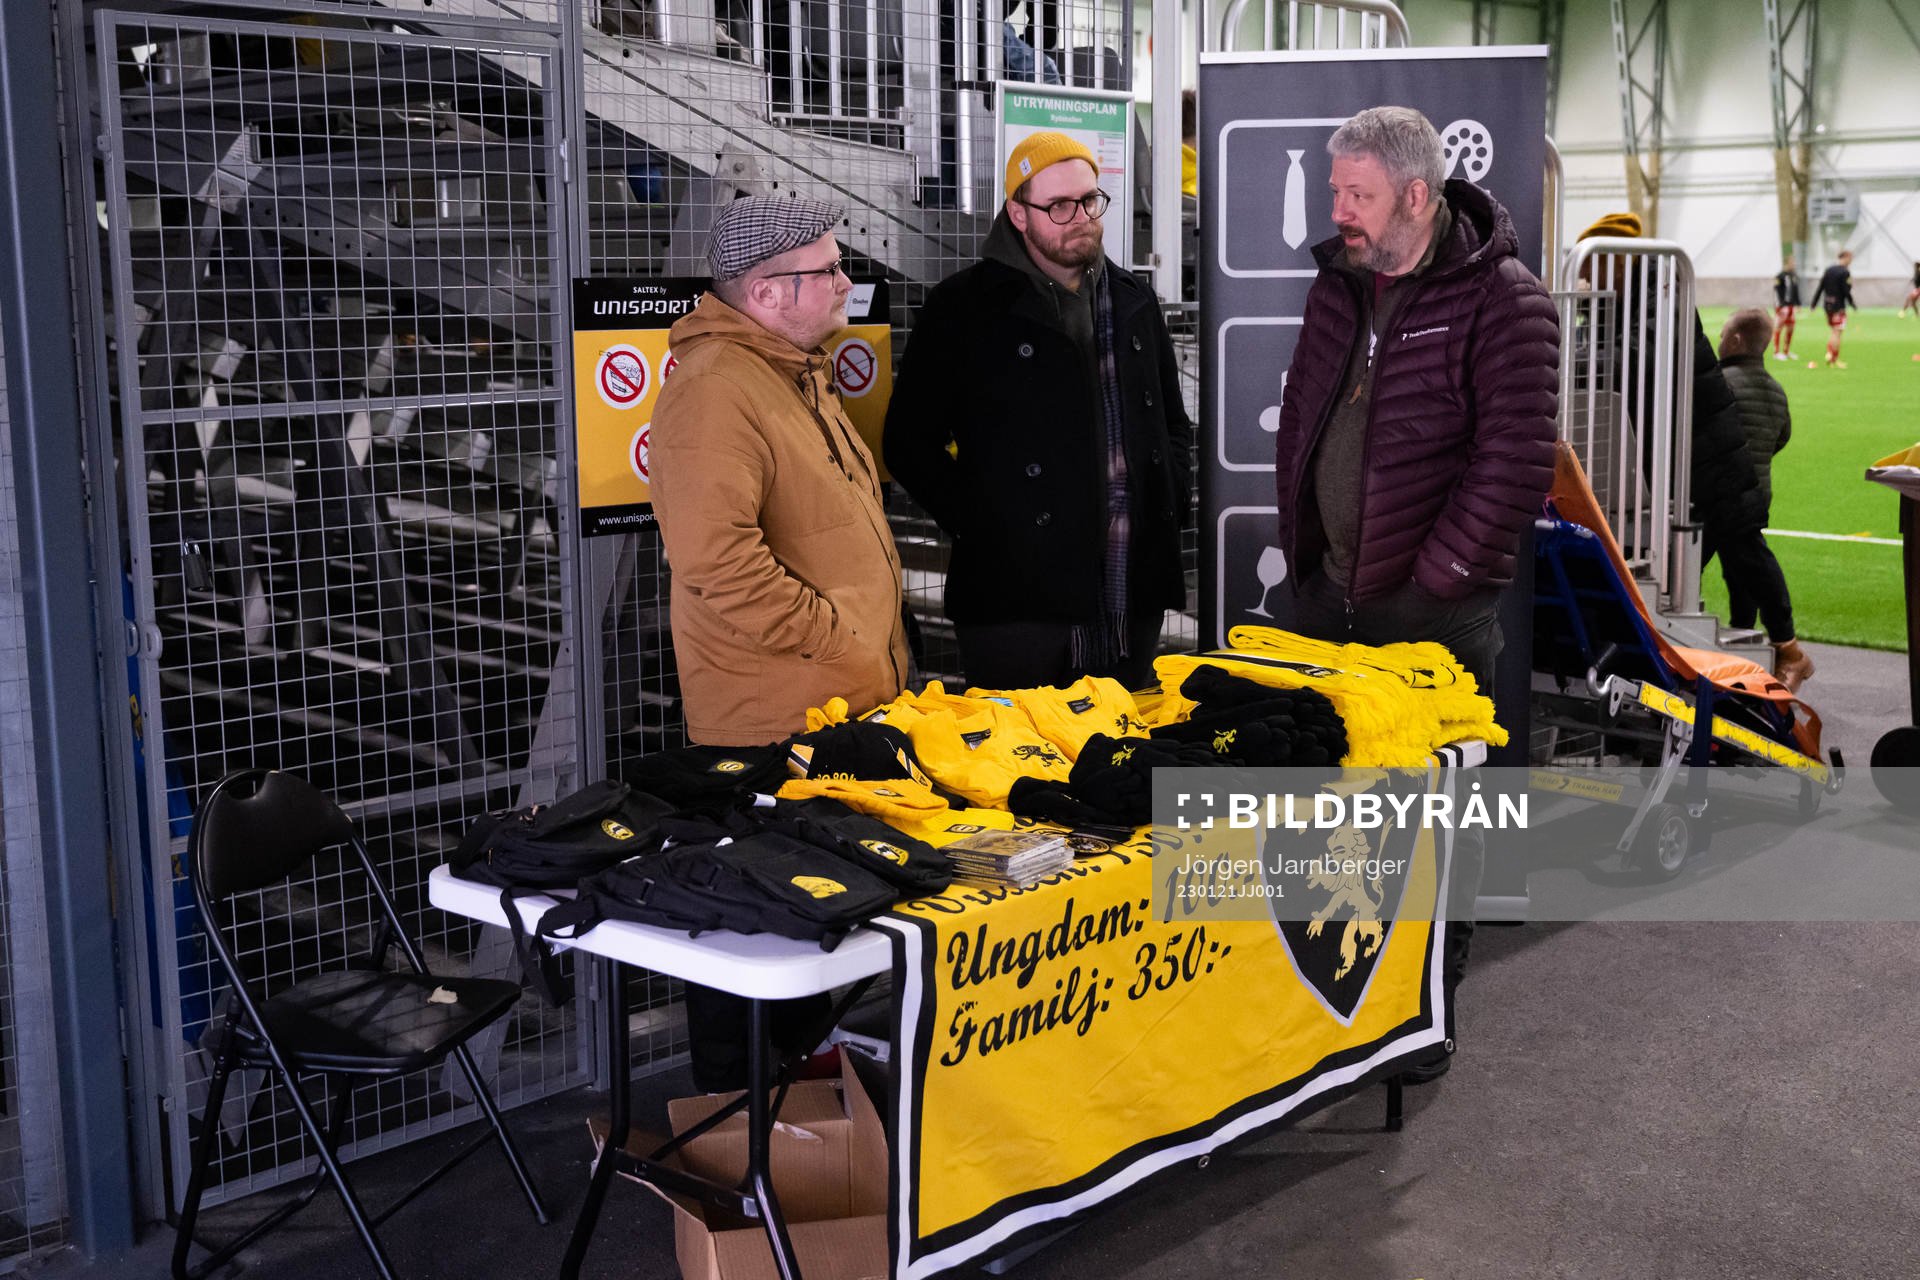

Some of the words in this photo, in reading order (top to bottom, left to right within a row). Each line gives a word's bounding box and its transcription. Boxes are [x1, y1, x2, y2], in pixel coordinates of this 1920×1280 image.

[1013, 95, 1117, 115] UTRYMNINGSPLAN
[633, 286, 659, 294] SALTEX
[659, 286, 667, 295] by
[593, 300, 691, 315] UNISPORT
[947, 897, 1150, 990] Ungdom:
[940, 966, 1114, 1067] Familj:
